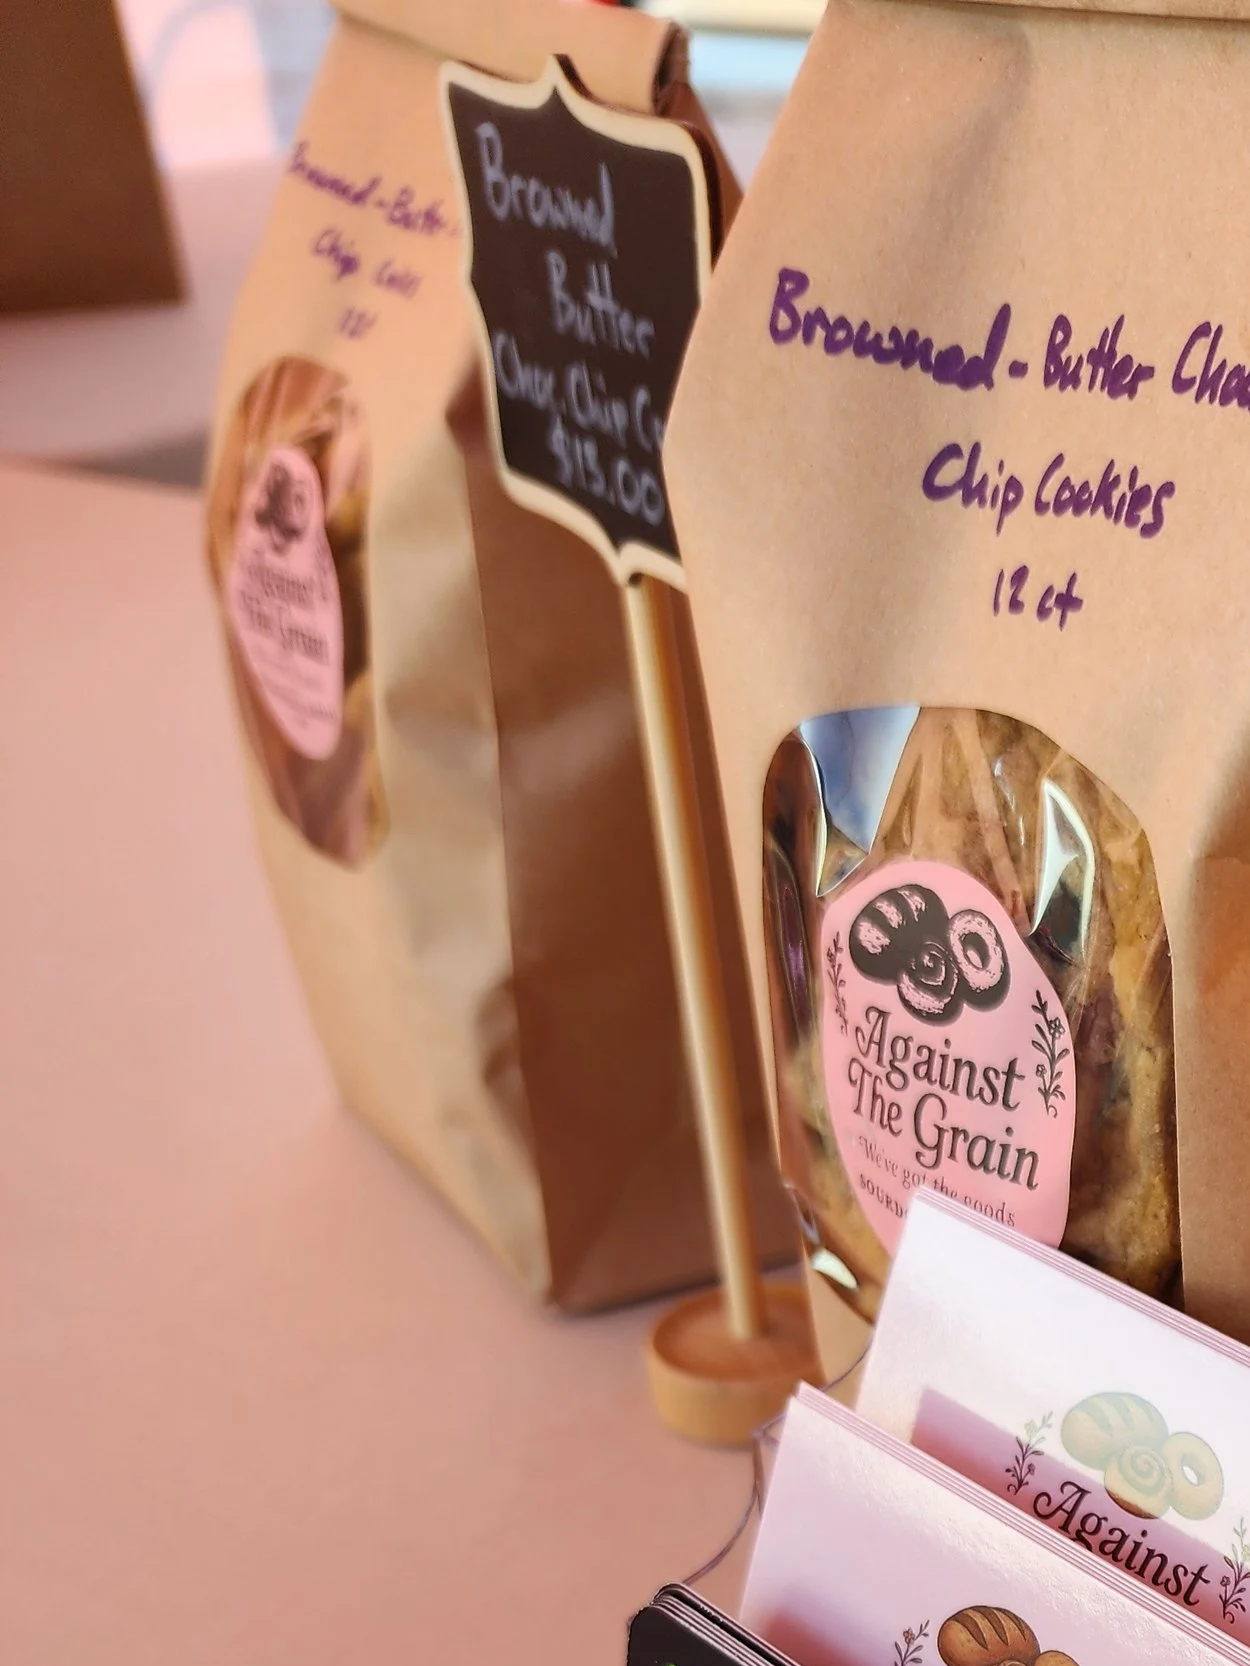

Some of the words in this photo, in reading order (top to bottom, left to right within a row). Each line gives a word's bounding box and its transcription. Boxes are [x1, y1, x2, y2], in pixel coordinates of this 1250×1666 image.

[921, 441, 1024, 537] Chip
[1034, 453, 1175, 539] Cookies
[994, 565, 1029, 617] 12
[1036, 572, 1084, 632] ct
[855, 1005, 1026, 1112] Against
[848, 1057, 903, 1138] The
[913, 1092, 1039, 1191] Grain
[859, 1173, 908, 1220] SOURD
[1033, 1480, 1211, 1607] Against
